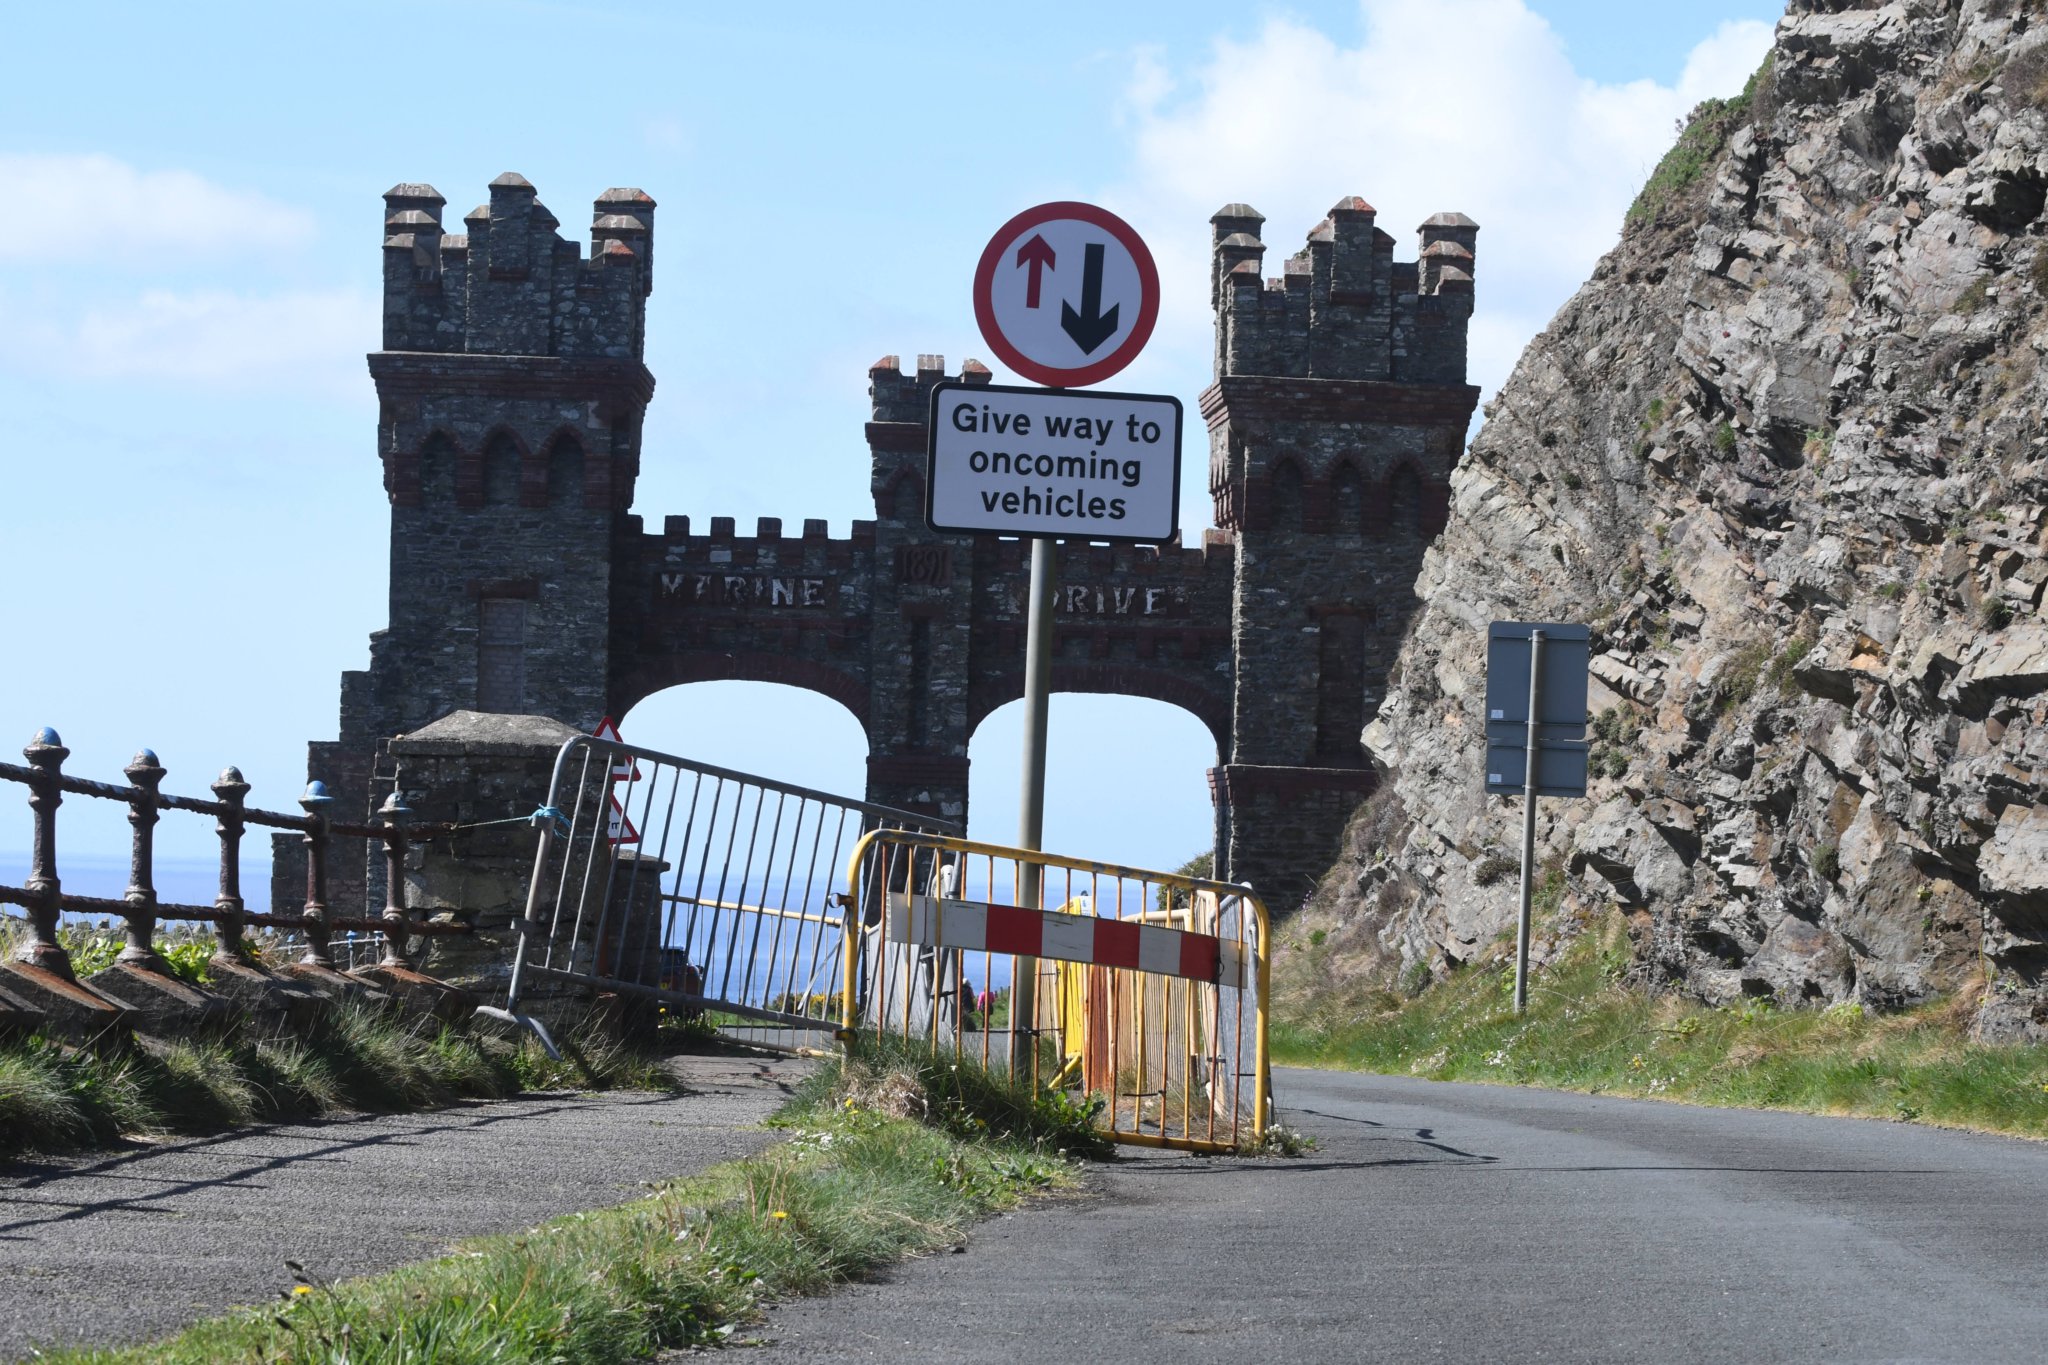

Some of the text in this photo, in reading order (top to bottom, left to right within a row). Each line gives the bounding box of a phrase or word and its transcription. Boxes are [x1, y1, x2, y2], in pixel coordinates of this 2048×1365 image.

[952, 402, 1161, 446] Give way to
[969, 450, 1141, 488] oncoming
[981, 485, 1126, 520] vehicles
[902, 548, 946, 585] 1891
[1053, 584, 1167, 615] RIVE
